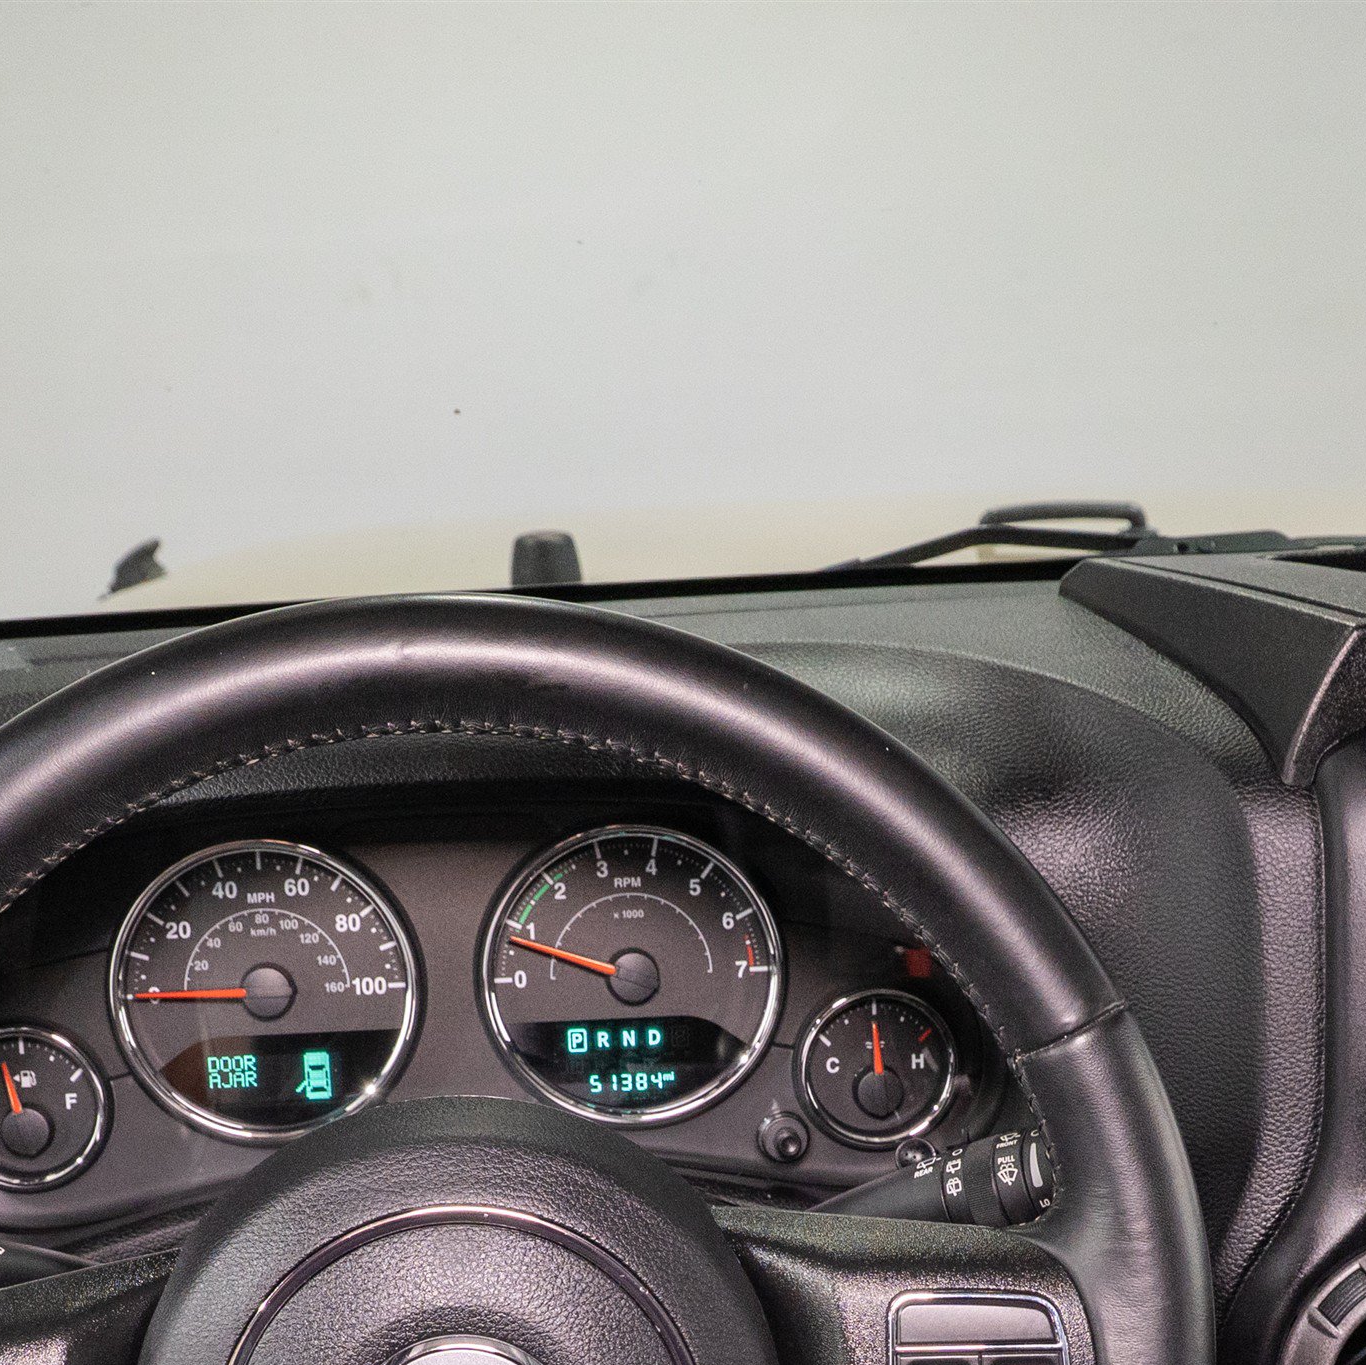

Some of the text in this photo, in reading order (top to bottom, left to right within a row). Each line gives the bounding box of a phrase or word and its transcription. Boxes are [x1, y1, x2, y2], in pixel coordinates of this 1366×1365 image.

[596, 861, 609, 878] 3
[645, 859, 658, 876] 4
[212, 881, 237, 899] 40
[284, 878, 310, 897] 60
[614, 877, 642, 888] RPM
[689, 879, 701, 896] 5
[247, 892, 276, 904] MPH
[554, 882, 567, 900] 2
[255, 913, 270, 924] 80
[621, 909, 645, 919] 1000
[722, 912, 735, 930] 6
[166, 921, 191, 939] 20
[228, 920, 243, 932] 60
[279, 918, 299, 930] 100
[335, 914, 361, 932] 80
[526, 922, 536, 940] 1
[250, 925, 277, 938] km/h
[299, 932, 320, 944] 120
[206, 937, 221, 948] 40
[194, 959, 209, 971] 20
[316, 954, 337, 966] 140
[735, 961, 748, 978] 7
[324, 981, 345, 994] 160
[351, 976, 388, 995] 100
[513, 970, 527, 989] 0
[571, 1029, 661, 1049] P R N D
[207, 1054, 257, 1073] DOOR
[826, 1057, 840, 1073] C
[911, 1053, 924, 1069] H
[209, 1072, 258, 1089] AJAR
[65, 1093, 78, 1110] F
[996, 1139, 1018, 1150] FRONT
[997, 1155, 1015, 1164] PULL
[914, 1165, 933, 1179] REAR
[1039, 1197, 1051, 1208] LO
